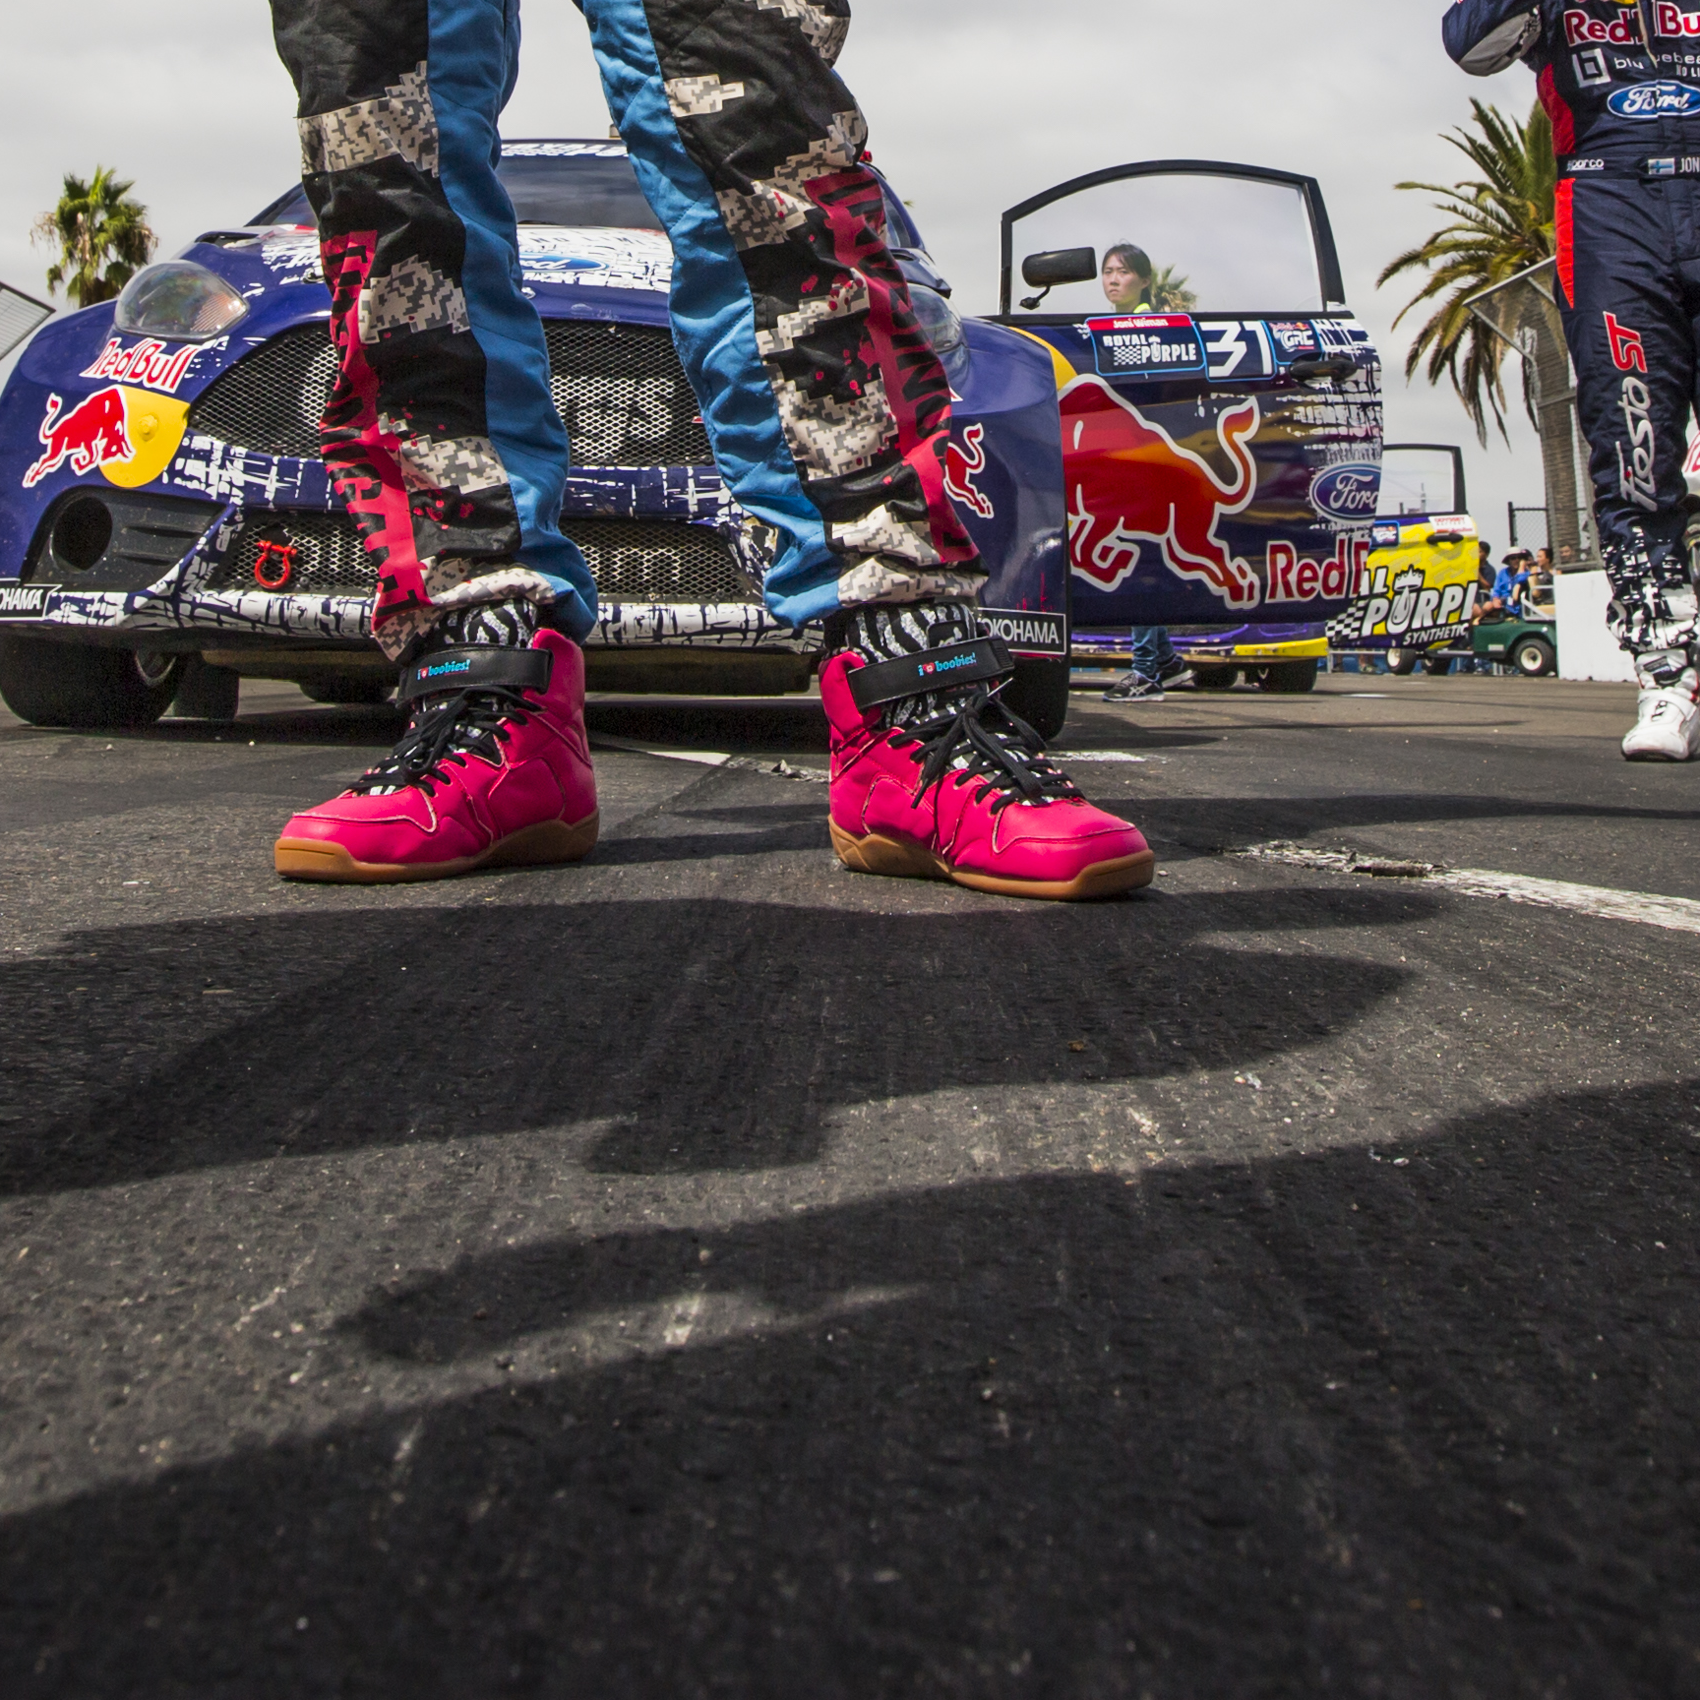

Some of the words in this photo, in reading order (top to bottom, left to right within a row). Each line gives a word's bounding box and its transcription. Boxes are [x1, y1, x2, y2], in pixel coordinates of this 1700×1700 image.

[1564, 9, 1630, 47] Red
[1623, 85, 1691, 113] Ford
[1113, 318, 1134, 328] Joni
[1135, 318, 1169, 328] Wiman
[1103, 334, 1148, 347] ROYAL
[1201, 321, 1273, 378] 31
[1284, 330, 1314, 347] GRC
[1603, 311, 1647, 374] ST
[81, 337, 153, 382] Red
[122, 338, 202, 394] Bull
[1142, 343, 1197, 364] PURPLE
[1618, 377, 1657, 512] Fiesta
[1265, 539, 1348, 603] Red
[981, 617, 1060, 644] OKOHAMA
[428, 659, 471, 678] boobies!
[934, 652, 977, 673] boobies!
